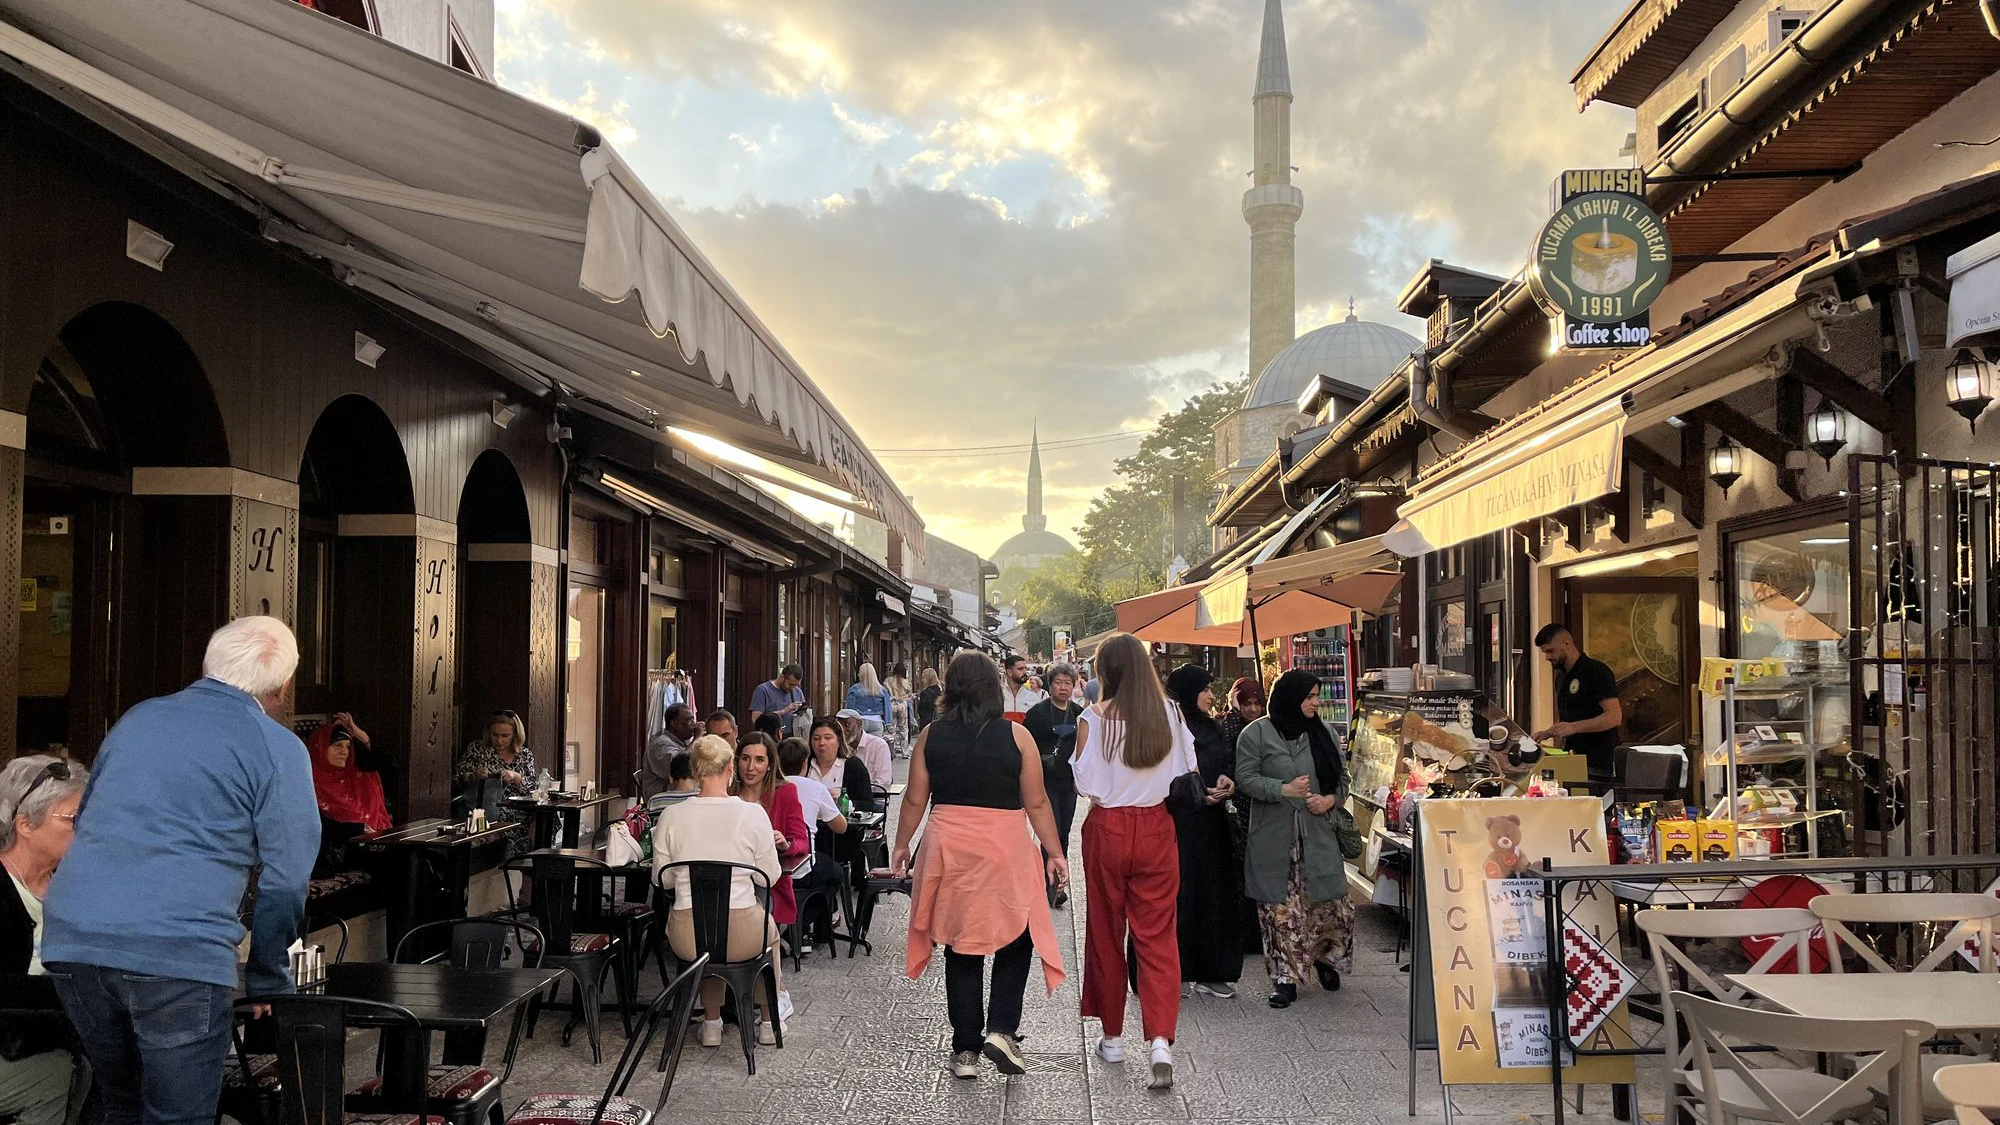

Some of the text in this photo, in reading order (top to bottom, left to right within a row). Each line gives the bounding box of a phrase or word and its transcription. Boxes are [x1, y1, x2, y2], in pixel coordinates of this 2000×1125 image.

[1566, 169, 1643, 198] MINASA
[1542, 199, 1667, 262] TUCANA KAHVA IZ DIBEKA
[1581, 296, 1623, 317] 1991
[1566, 321, 1650, 346] Coffee shop
[1560, 453, 1607, 489] MINASA
[1428, 696, 1447, 704] made
[1491, 889, 1545, 905] MINAS
[1438, 829, 1482, 1051] TUCANA
[1518, 1022, 1550, 1041] MINAS
